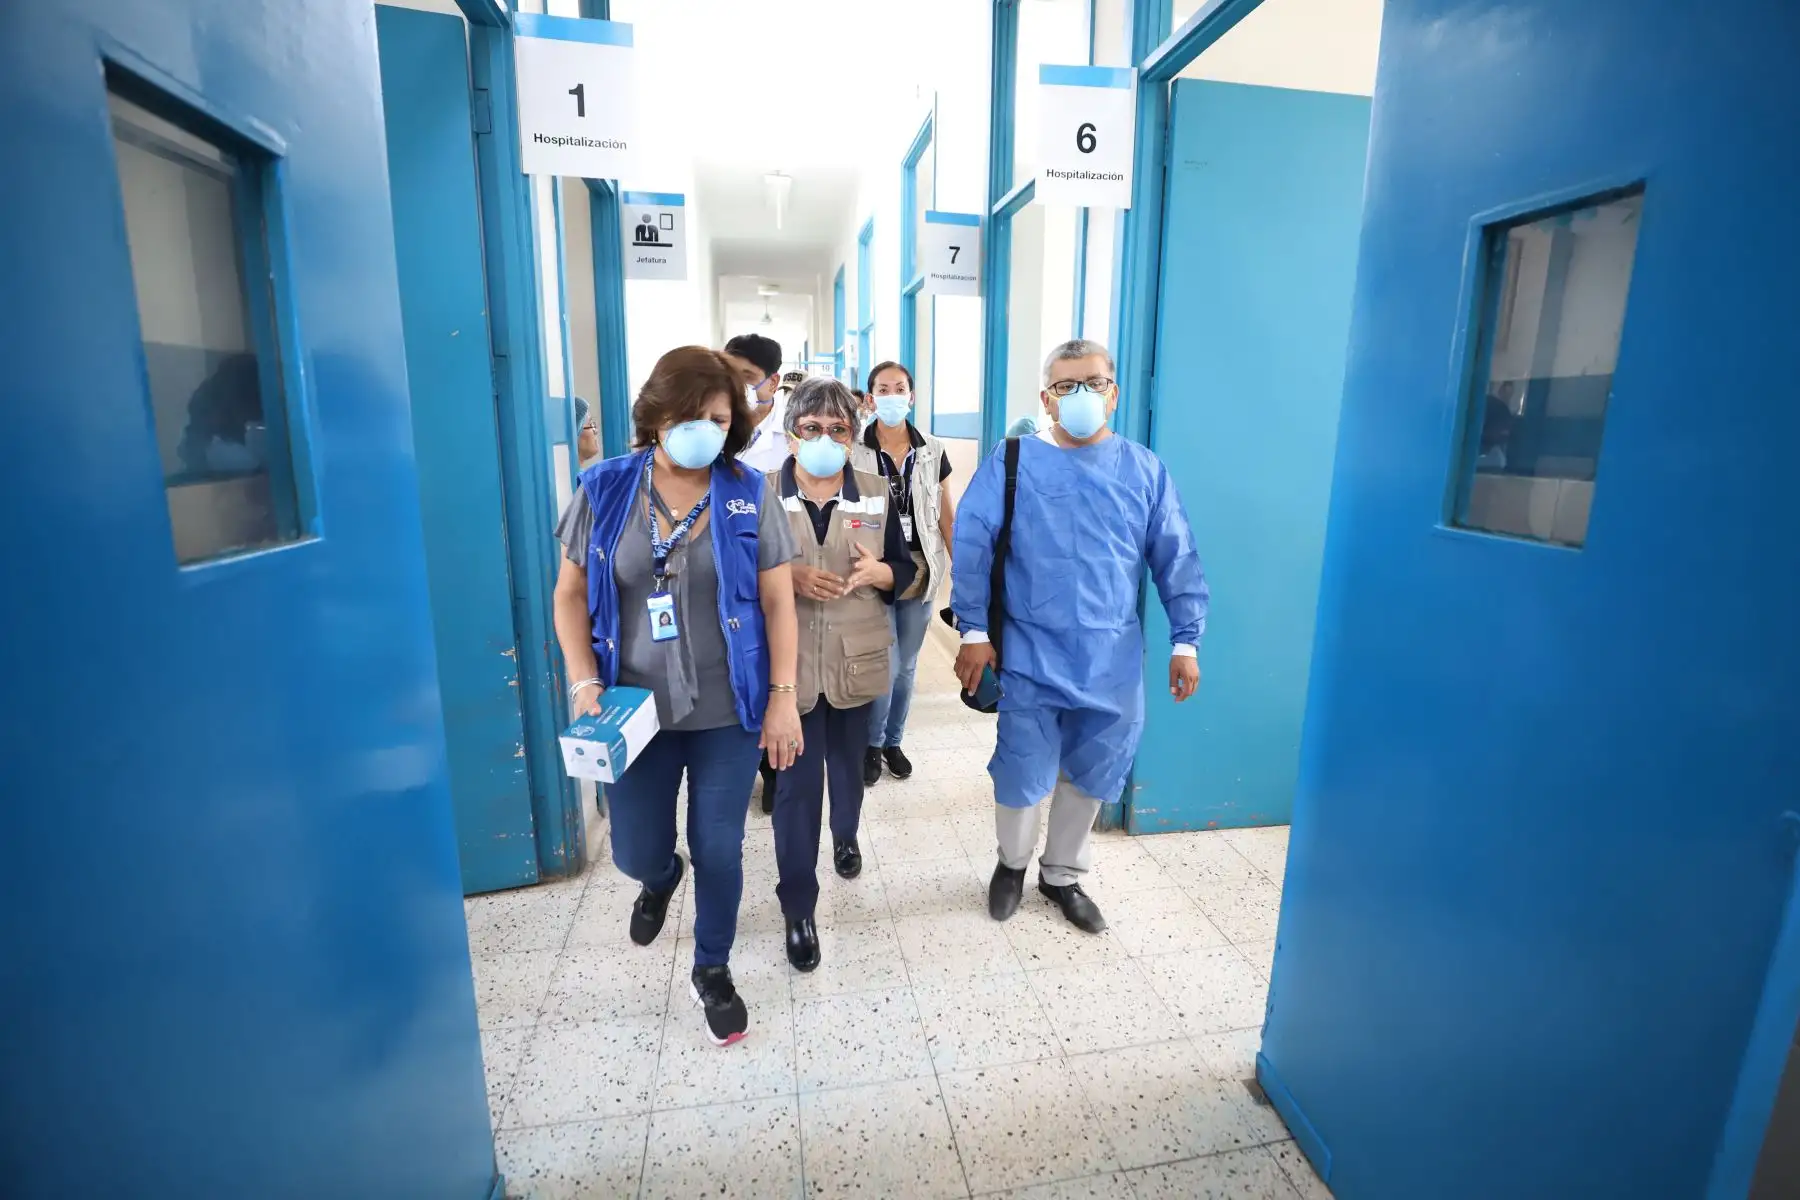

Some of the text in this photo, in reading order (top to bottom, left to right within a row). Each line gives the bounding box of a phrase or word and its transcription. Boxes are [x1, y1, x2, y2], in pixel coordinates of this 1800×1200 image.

[568, 83, 586, 118] 1
[533, 132, 628, 150] Hospitalización
[1076, 122, 1098, 154] 6
[1046, 168, 1125, 181] Hospitalización
[636, 256, 667, 264] Jefatura
[948, 245, 961, 265] 7
